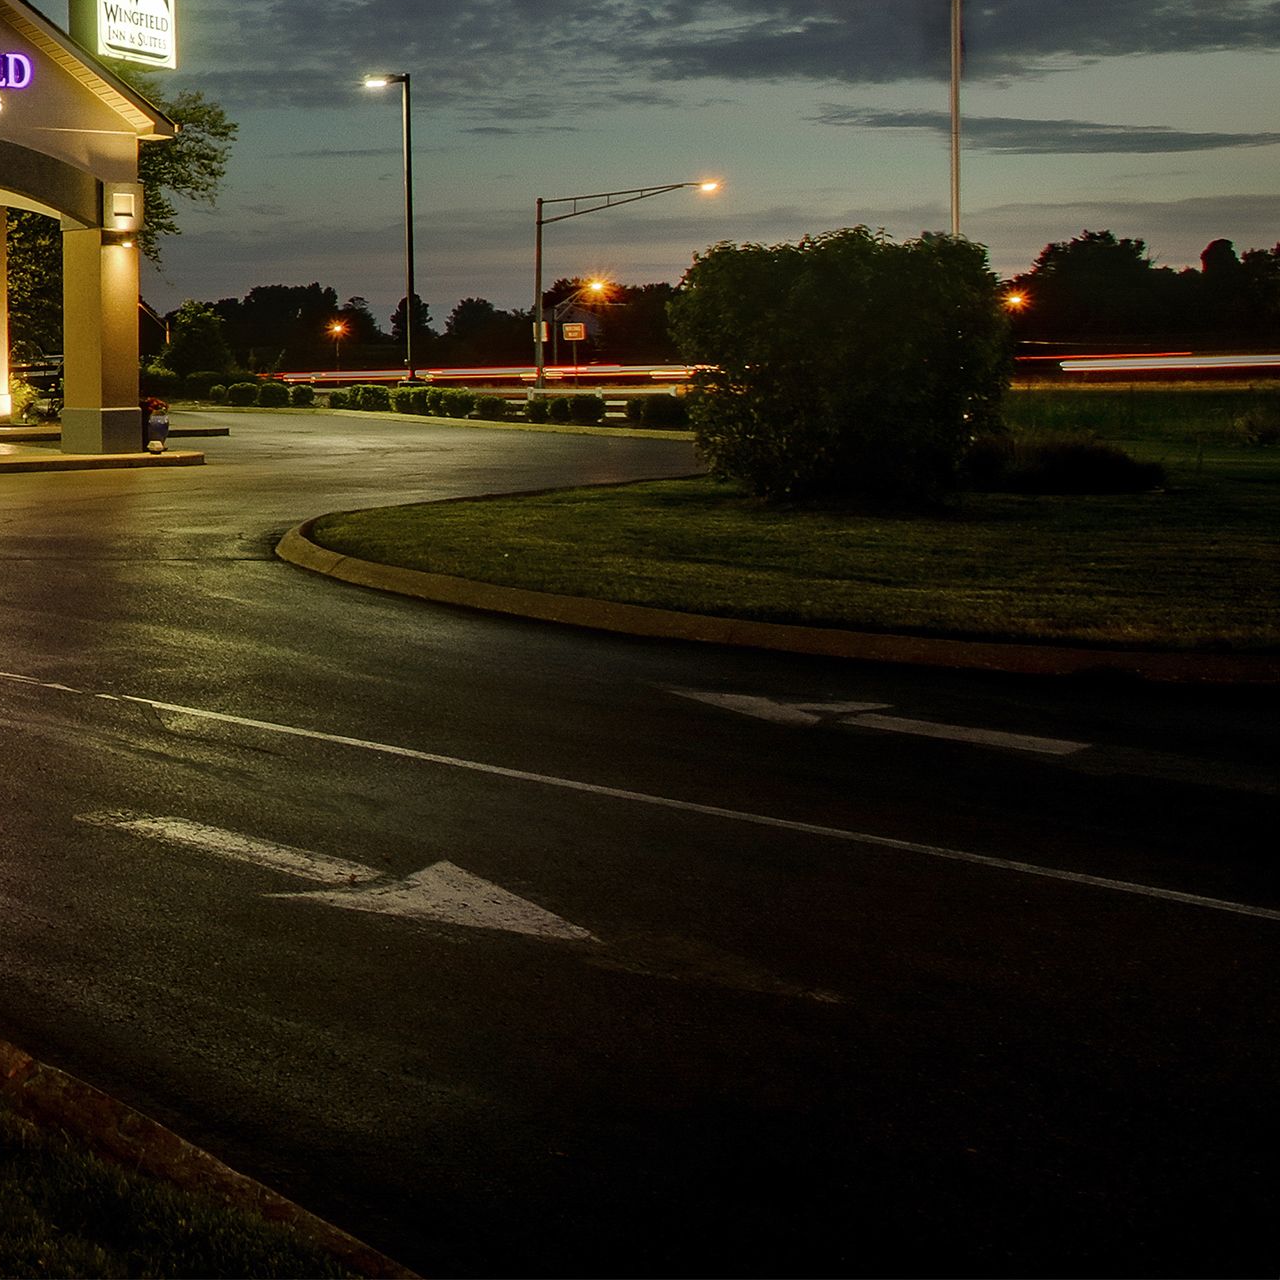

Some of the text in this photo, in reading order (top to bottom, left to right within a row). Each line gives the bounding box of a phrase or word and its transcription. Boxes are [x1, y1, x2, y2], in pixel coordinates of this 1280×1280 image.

[104, 1, 169, 32] WINGFIELD
[108, 25, 126, 40] INN
[138, 32, 167, 50] SUITES
